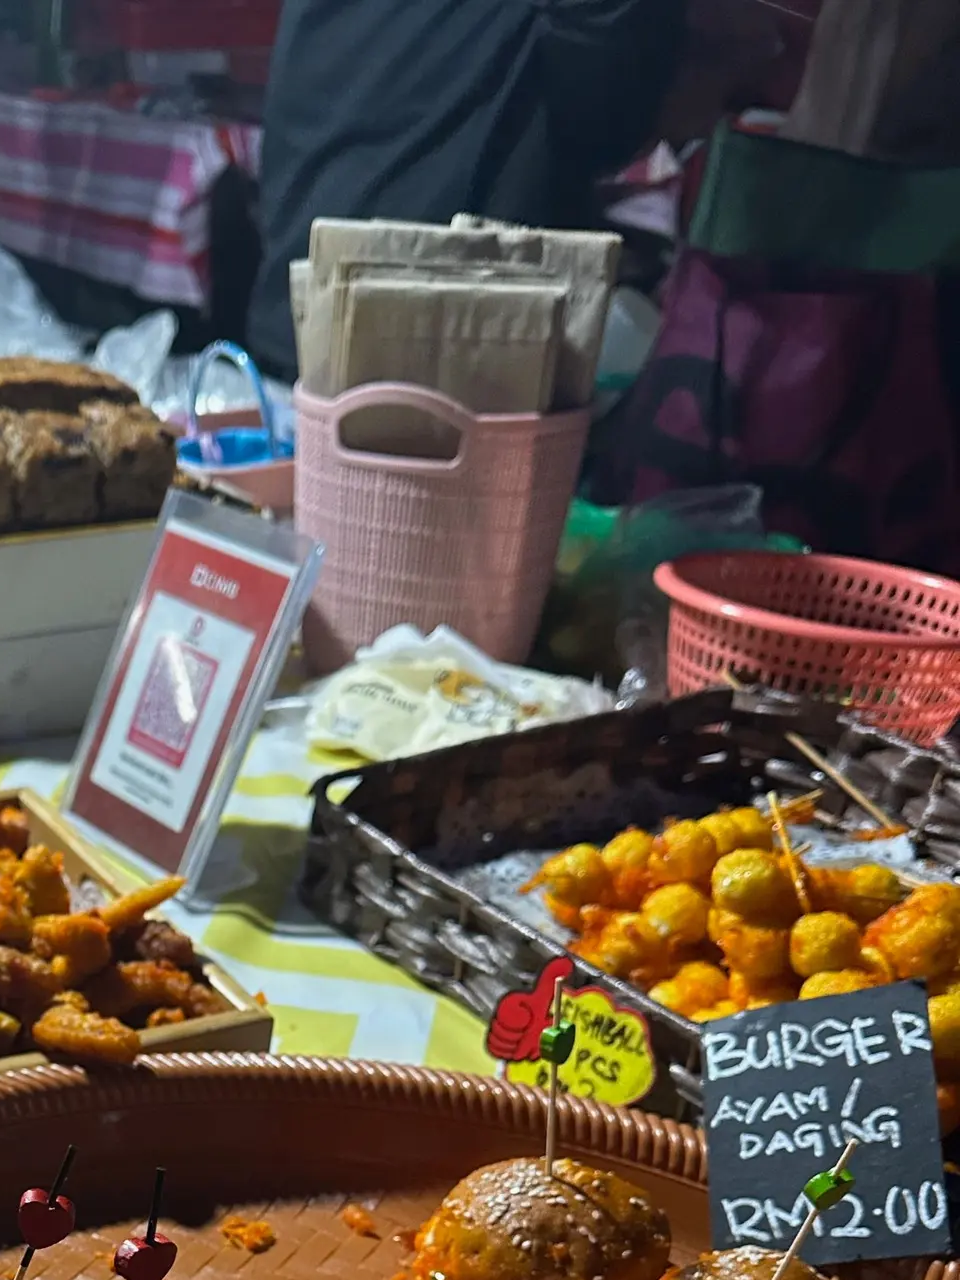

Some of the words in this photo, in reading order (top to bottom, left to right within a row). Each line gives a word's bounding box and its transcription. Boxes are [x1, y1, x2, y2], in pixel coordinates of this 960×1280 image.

[574, 1048, 622, 1084] PCS
[703, 1010, 933, 1082] BURGER
[739, 1106, 902, 1159] DAGING
